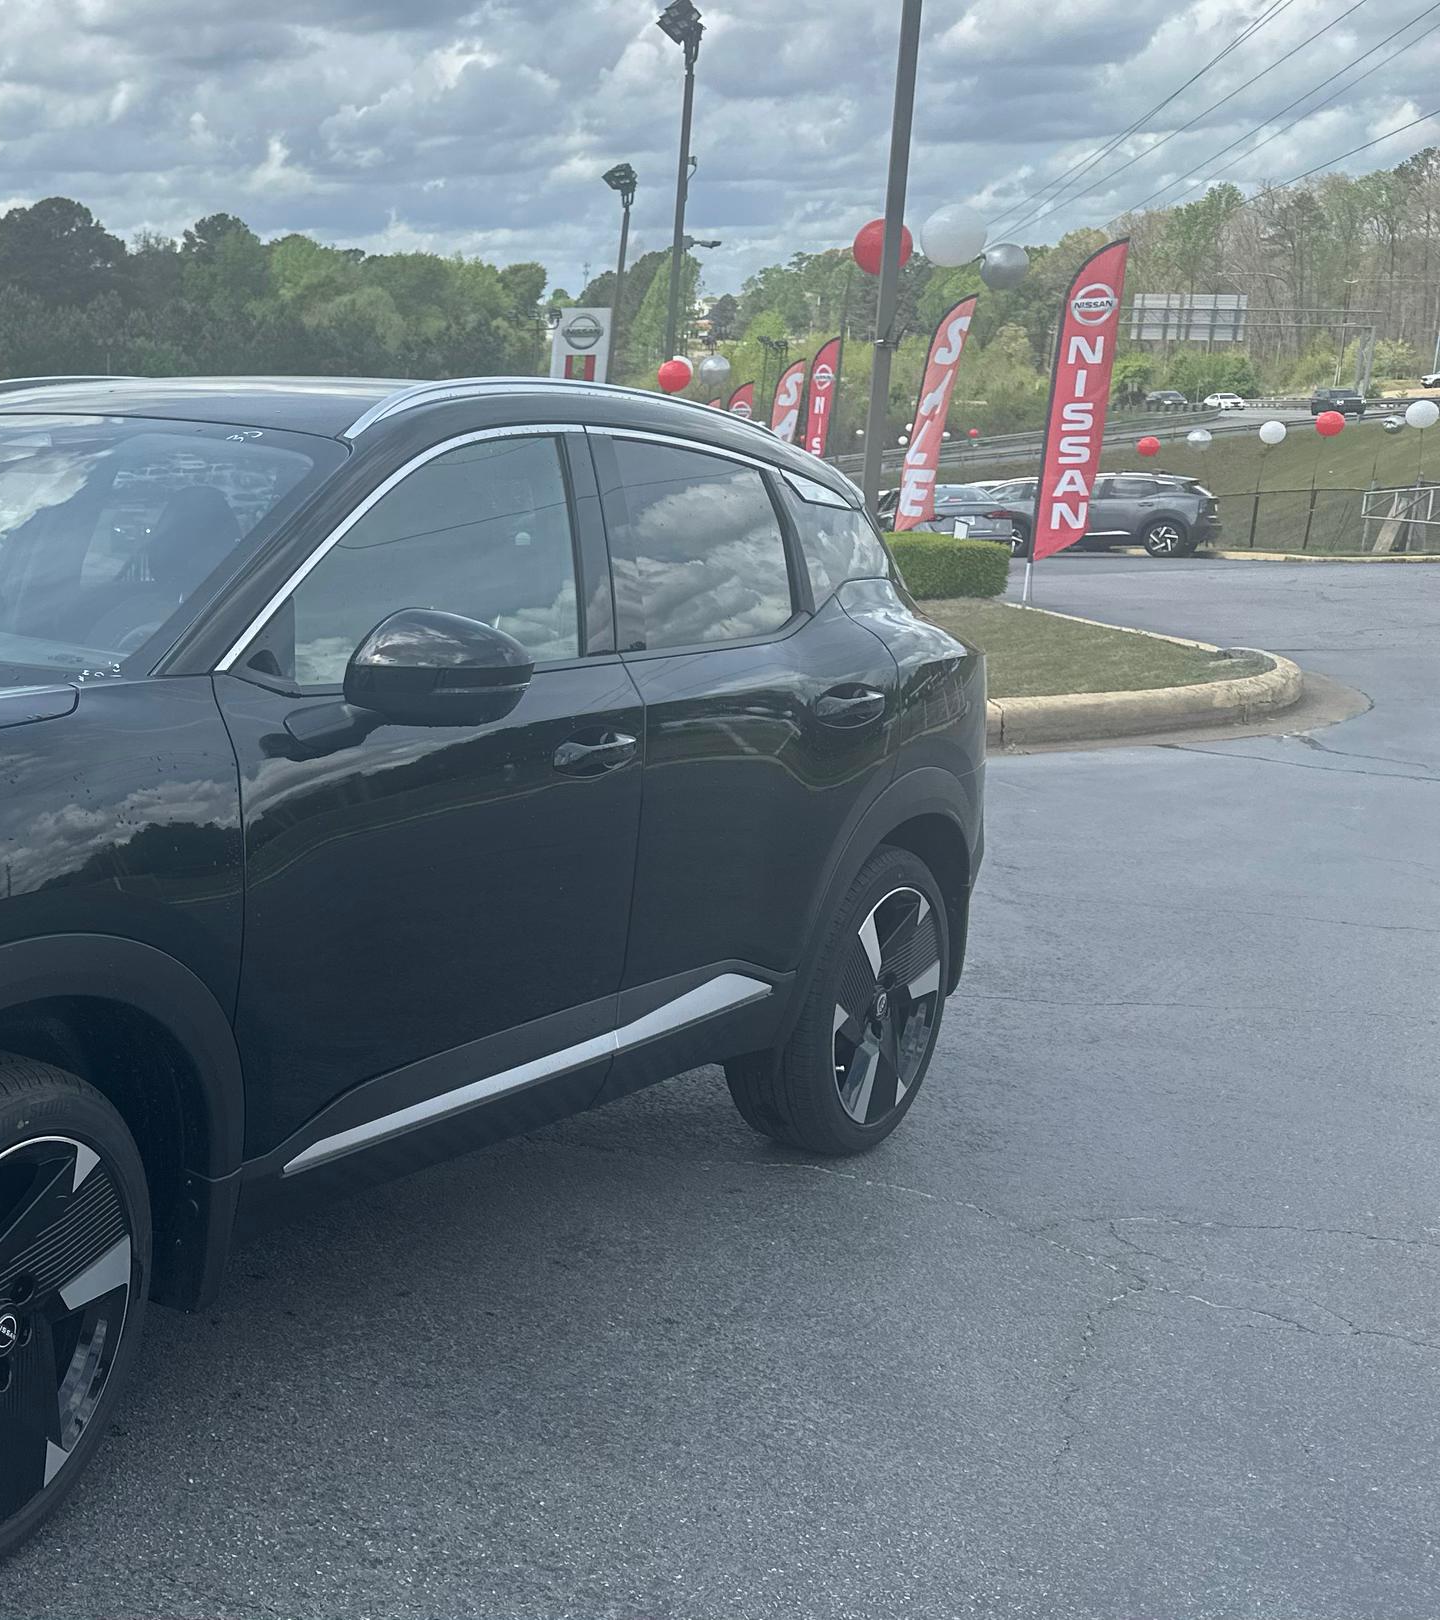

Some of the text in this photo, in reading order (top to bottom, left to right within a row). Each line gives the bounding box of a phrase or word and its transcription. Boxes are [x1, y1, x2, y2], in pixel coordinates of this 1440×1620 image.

[1074, 300, 1113, 309] NISSAN
[810, 396, 825, 455] NIS
[1050, 336, 1104, 530] NISSAN
